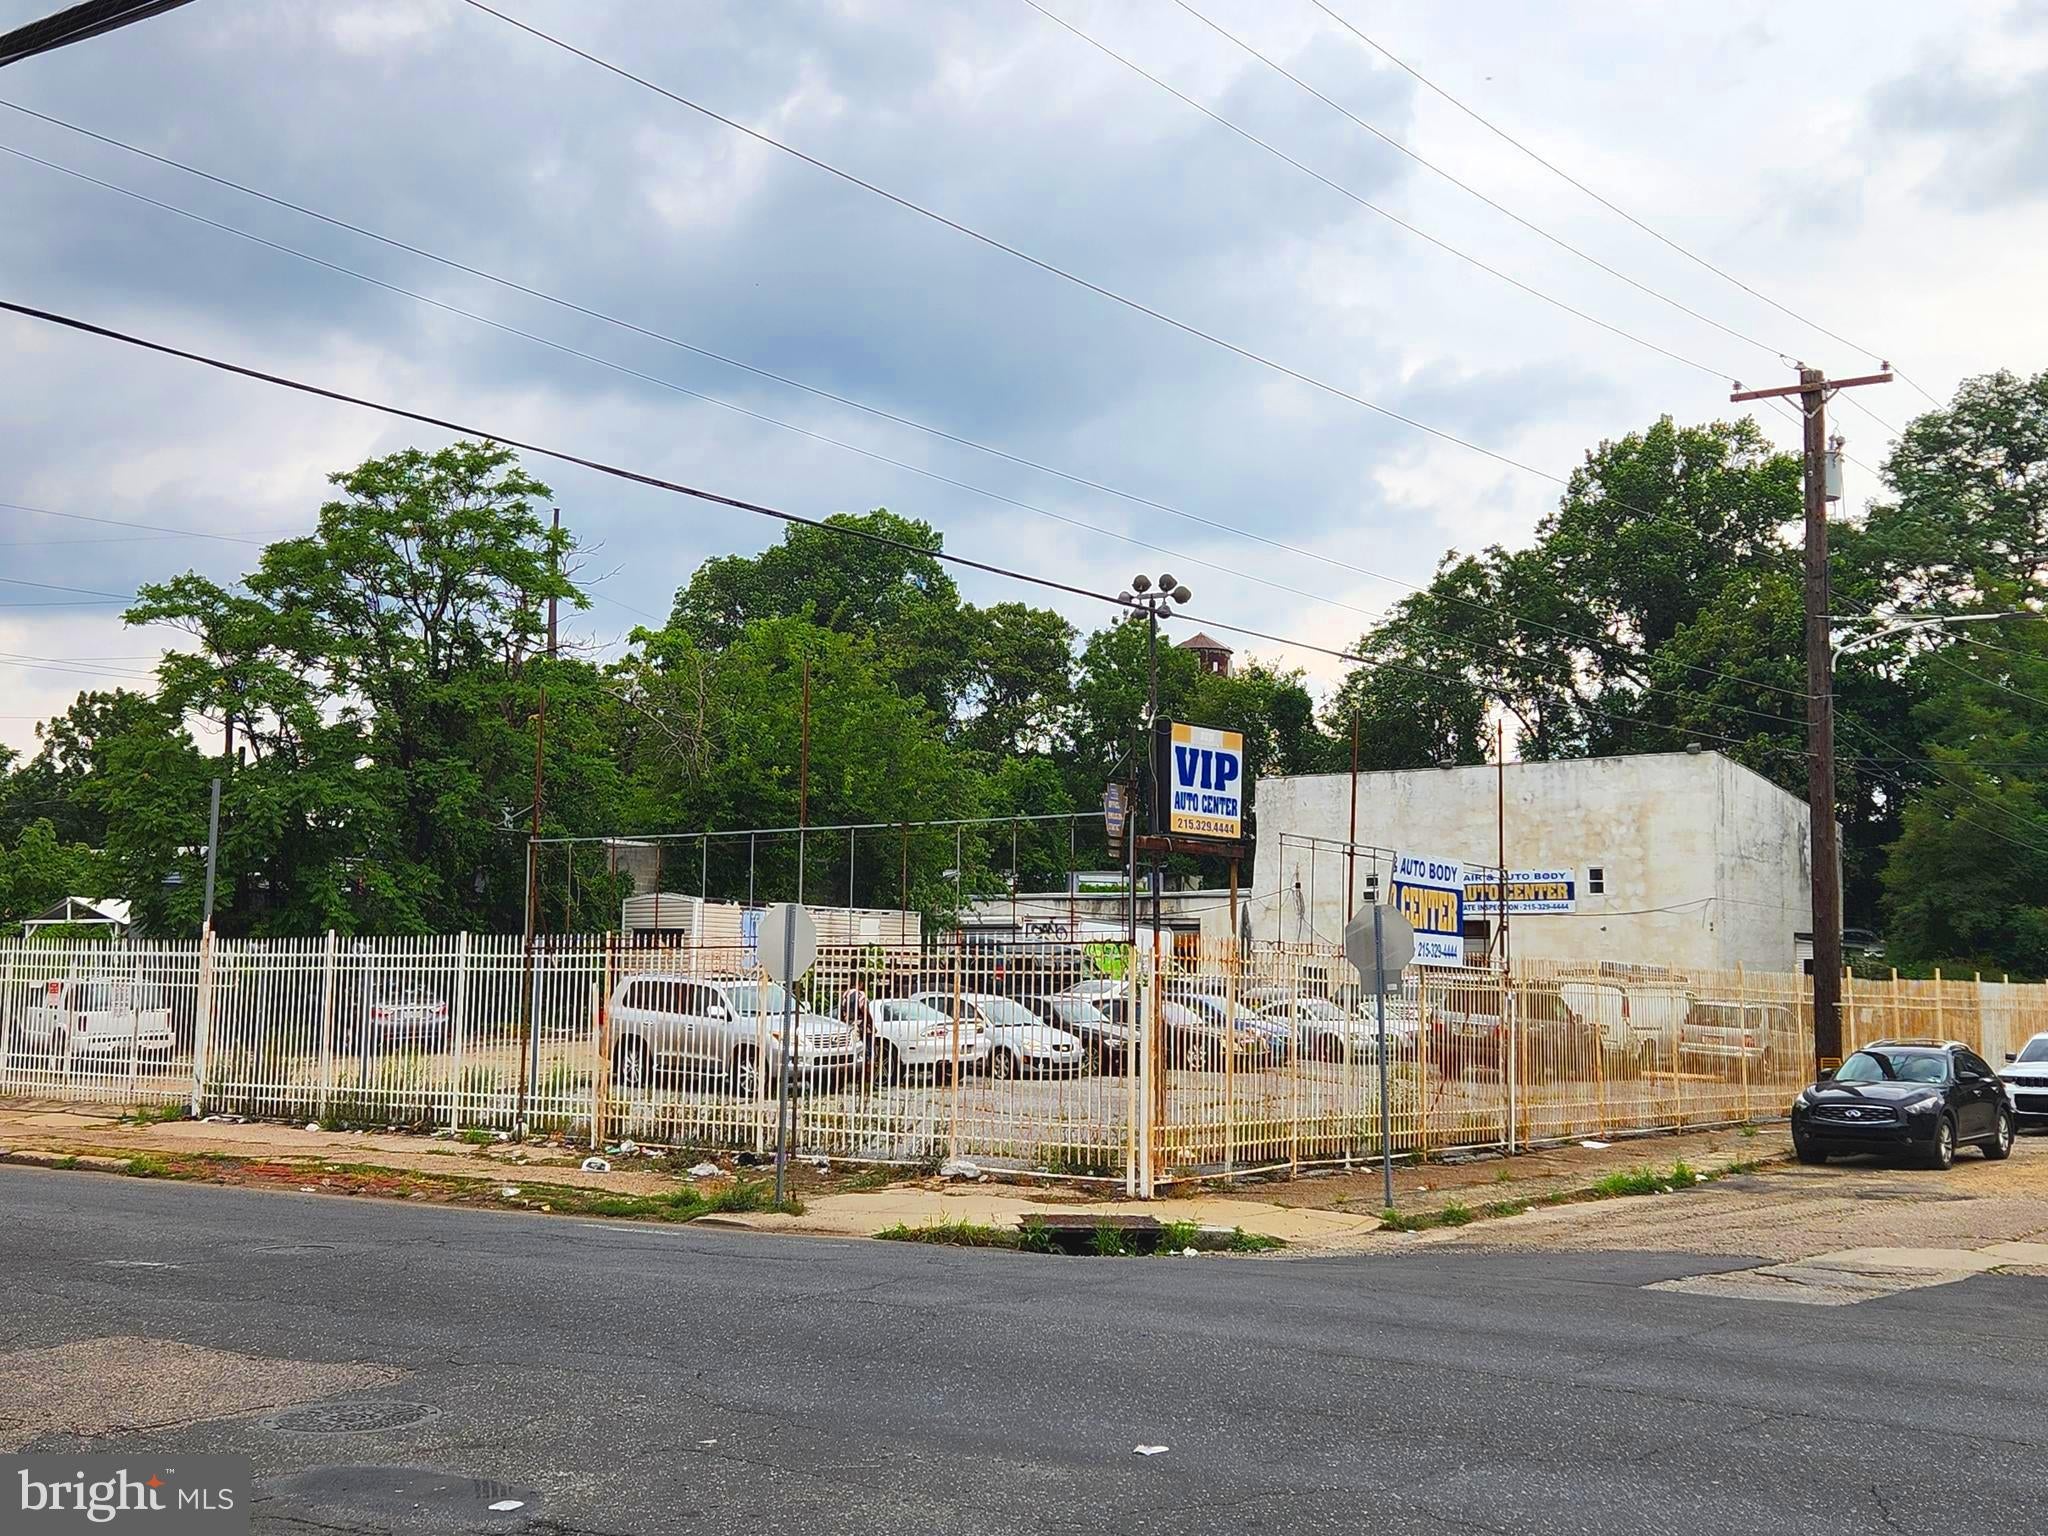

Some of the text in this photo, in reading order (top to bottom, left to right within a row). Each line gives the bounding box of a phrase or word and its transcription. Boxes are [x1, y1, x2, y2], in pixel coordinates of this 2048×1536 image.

[1175, 745, 1239, 791] VIP
[1174, 791, 1238, 817] AUTO CENTER
[1178, 818, 1234, 834] 215.329.4444
[1400, 858, 1426, 878] AUTO
[1429, 863, 1458, 882] BODY
[1463, 873, 1483, 881] AIR
[1500, 872, 1530, 881] UTO
[1534, 872, 1566, 880] BODY
[1503, 883, 1569, 900] CENTER
[1401, 885, 1458, 933] CENTER
